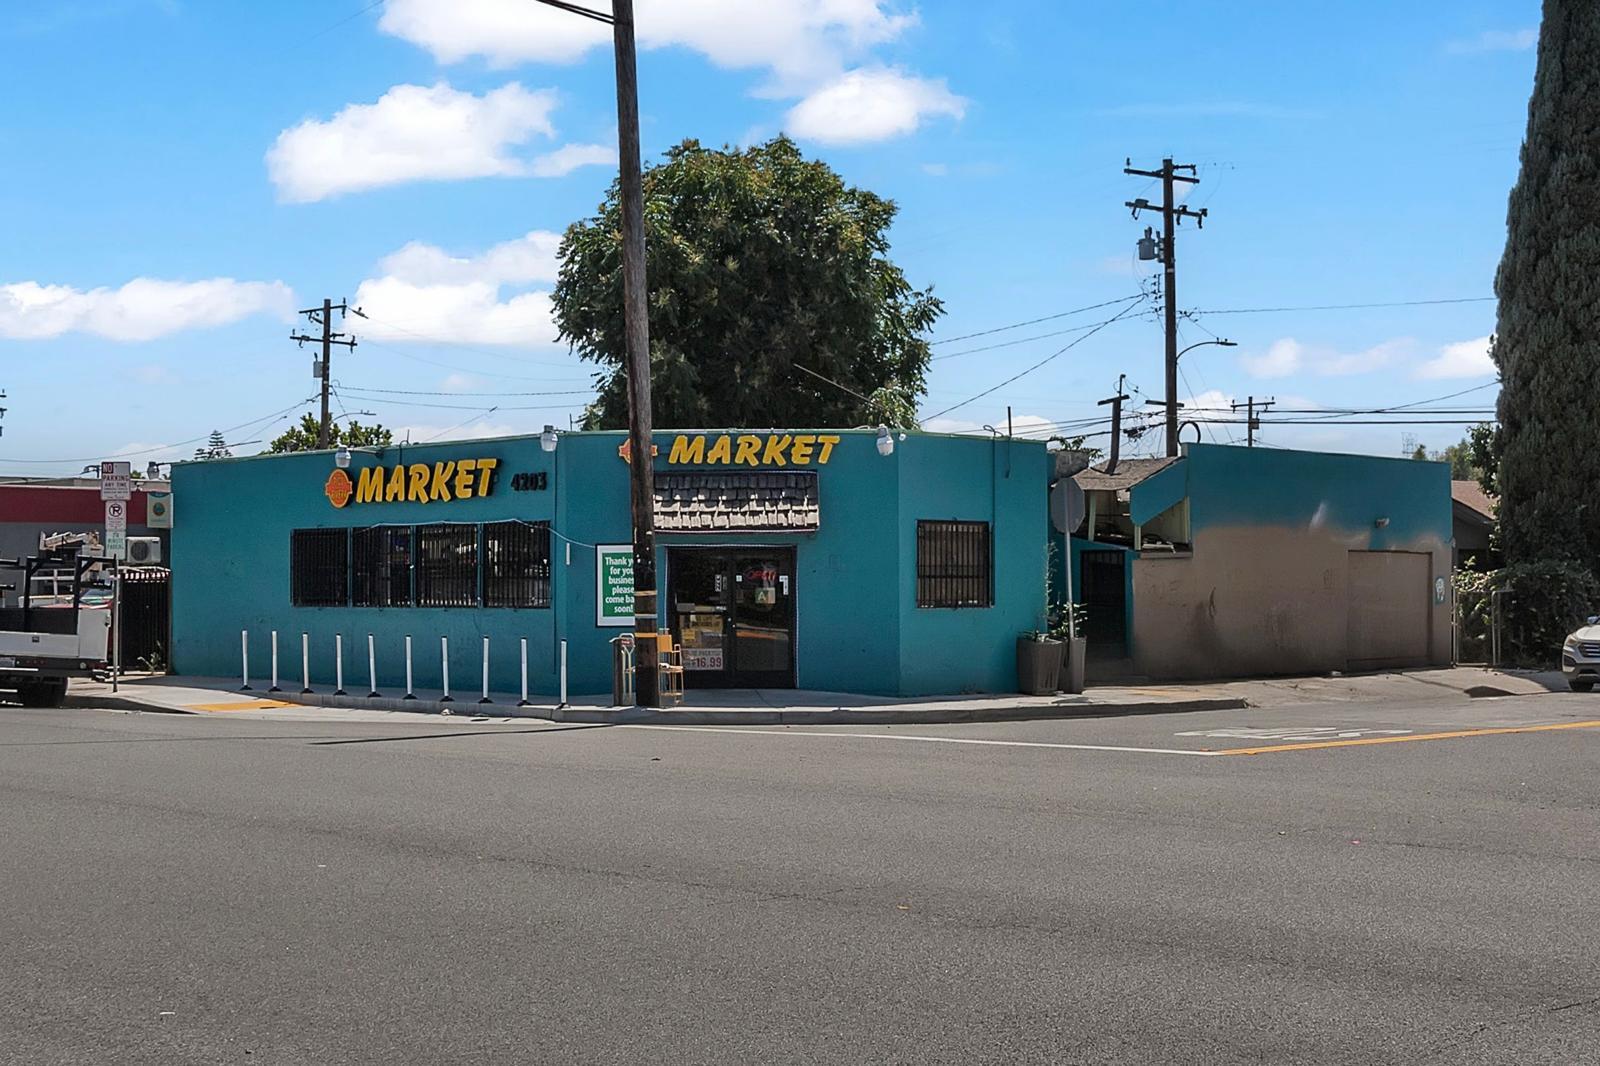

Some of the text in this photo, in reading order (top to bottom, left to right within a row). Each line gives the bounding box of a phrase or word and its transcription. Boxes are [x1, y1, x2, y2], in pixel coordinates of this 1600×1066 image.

[668, 434, 841, 467] MARKET
[103, 463, 113, 473] NO
[355, 457, 499, 505] MARKET
[510, 471, 548, 491] 4203
[604, 556, 627, 566] Thank
[609, 566, 621, 575] for
[612, 585, 635, 596] please
[605, 594, 635, 604] come ba
[757, 591, 767, 601] A
[614, 604, 634, 613] soon!
[696, 656, 722, 668] 16.99
